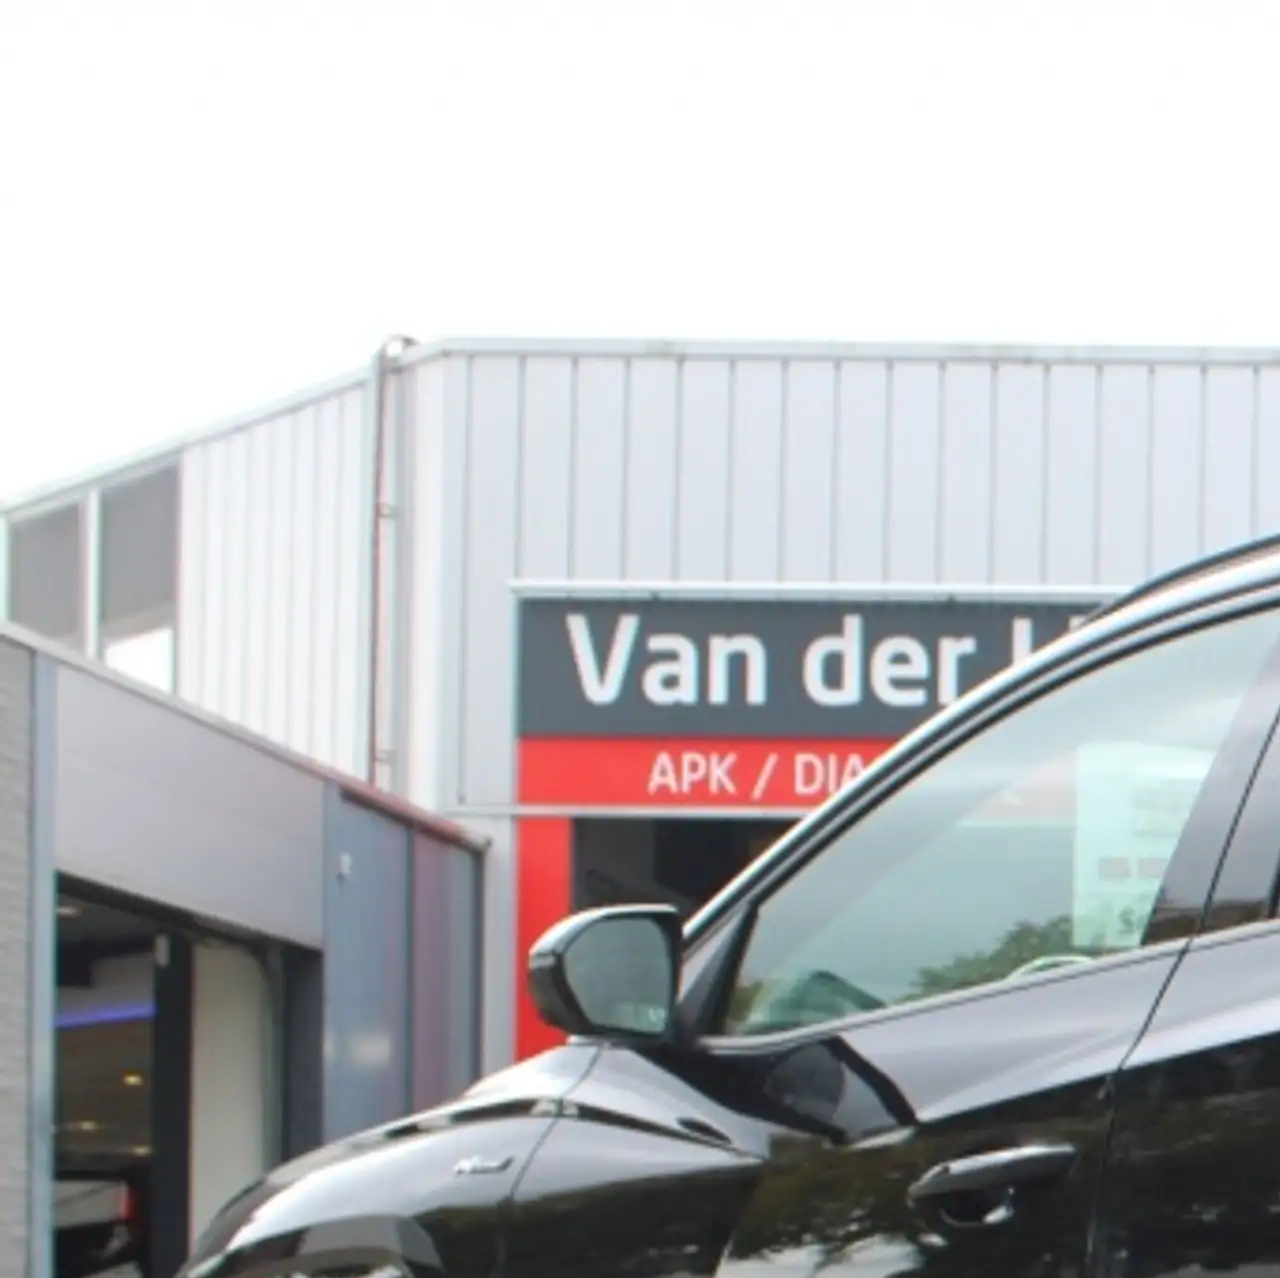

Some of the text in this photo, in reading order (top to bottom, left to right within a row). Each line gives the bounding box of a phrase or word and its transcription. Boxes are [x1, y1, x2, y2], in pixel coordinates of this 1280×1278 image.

[566, 613, 767, 706] Van
[803, 614, 977, 706] der
[647, 751, 738, 795] APK
[752, 753, 779, 800] /
